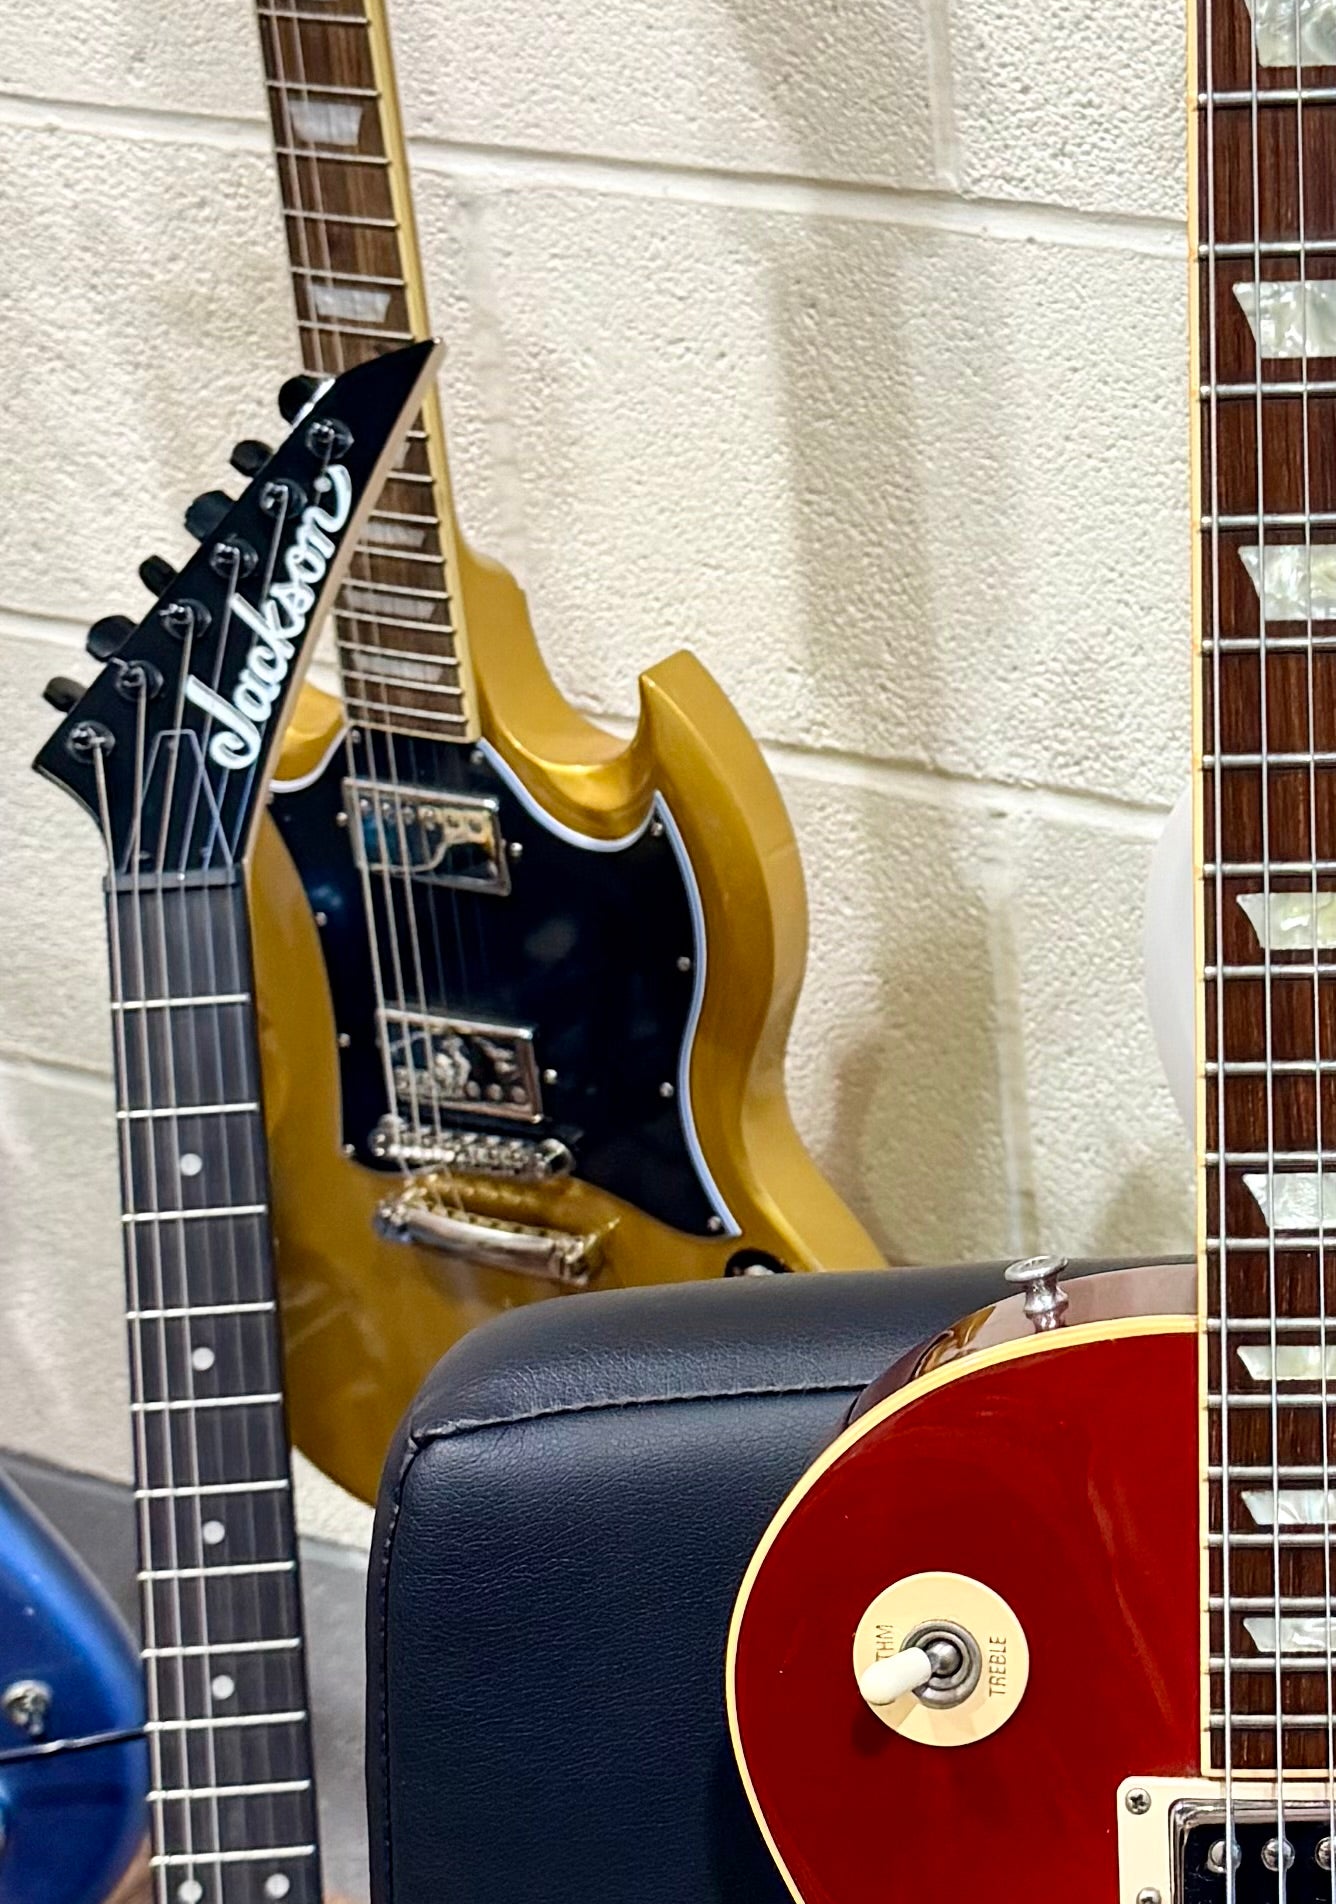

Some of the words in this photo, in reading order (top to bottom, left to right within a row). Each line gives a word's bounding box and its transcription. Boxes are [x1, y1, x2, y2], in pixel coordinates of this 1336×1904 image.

[184, 464, 352, 769] Jackson
[875, 1624, 895, 1662] THM
[989, 1635, 1007, 1697] TREBLE
